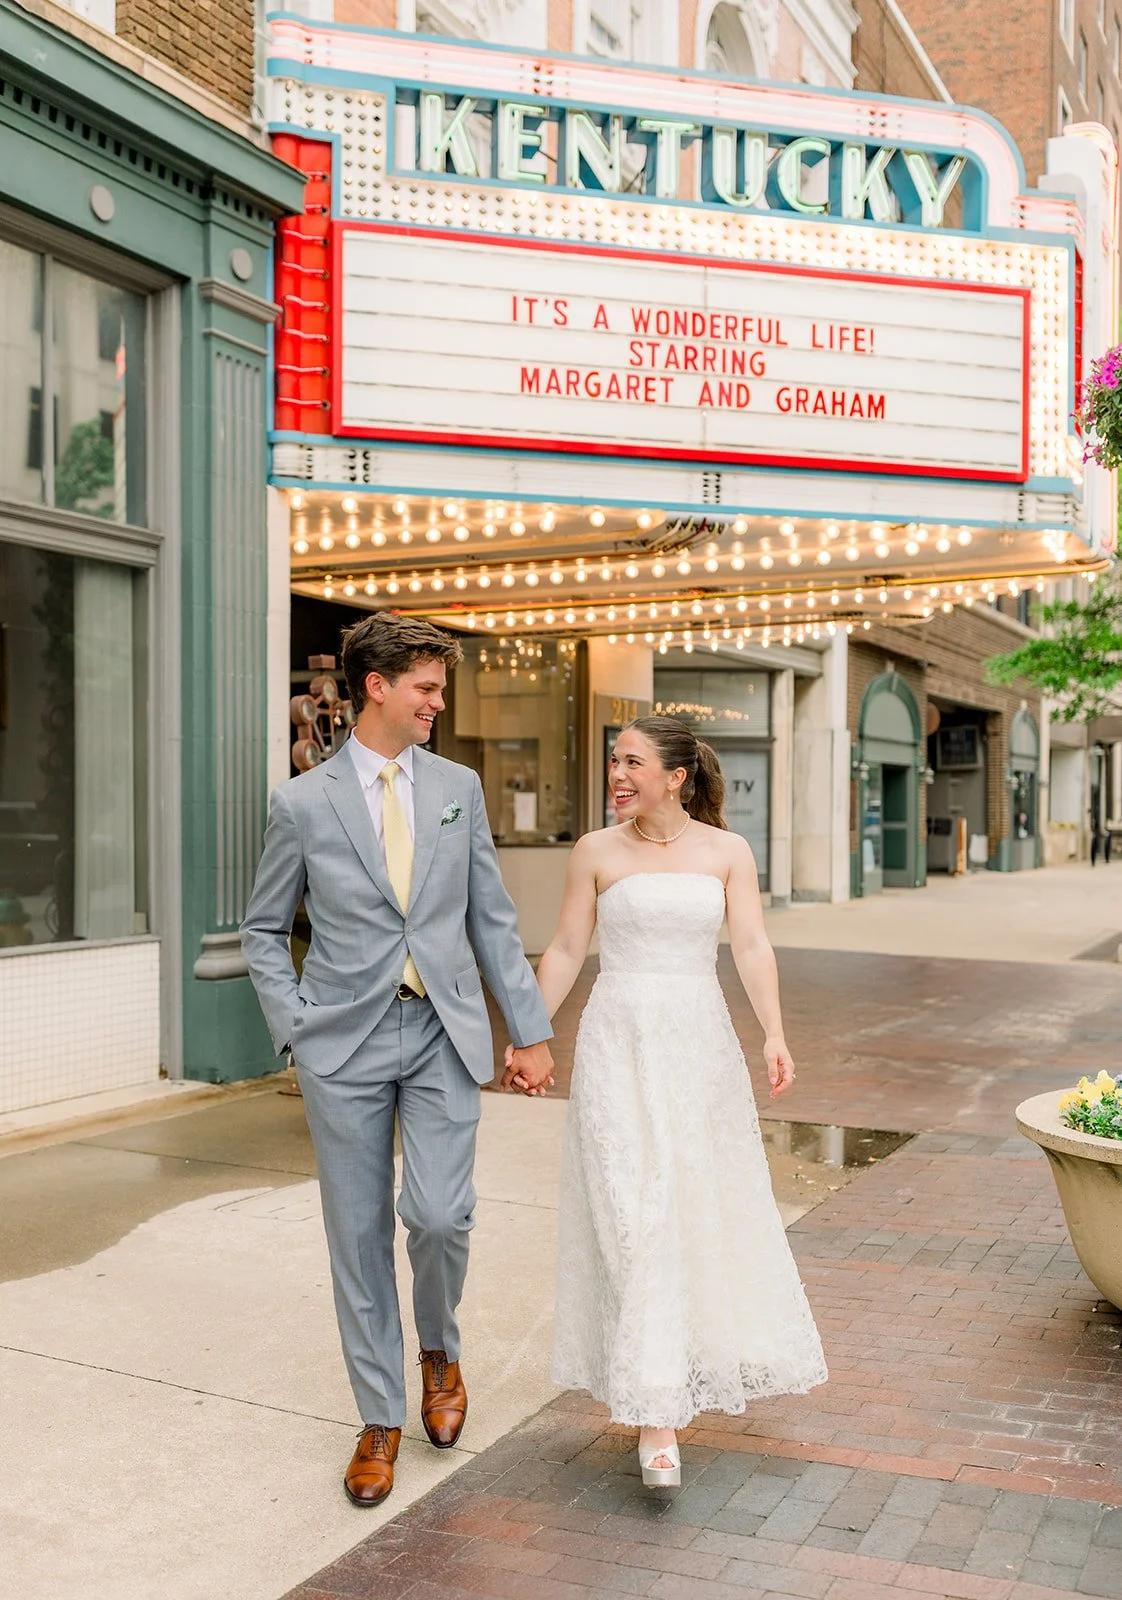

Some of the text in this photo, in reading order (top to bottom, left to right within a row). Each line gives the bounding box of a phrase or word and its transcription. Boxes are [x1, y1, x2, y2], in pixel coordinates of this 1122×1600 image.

[419, 91, 967, 228] KENTUCKY
[512, 296, 875, 353] IT'S A WONDERFUL LIFE!
[629, 340, 766, 378] STARRING
[520, 366, 886, 420] MARGARET AND GRAHAM
